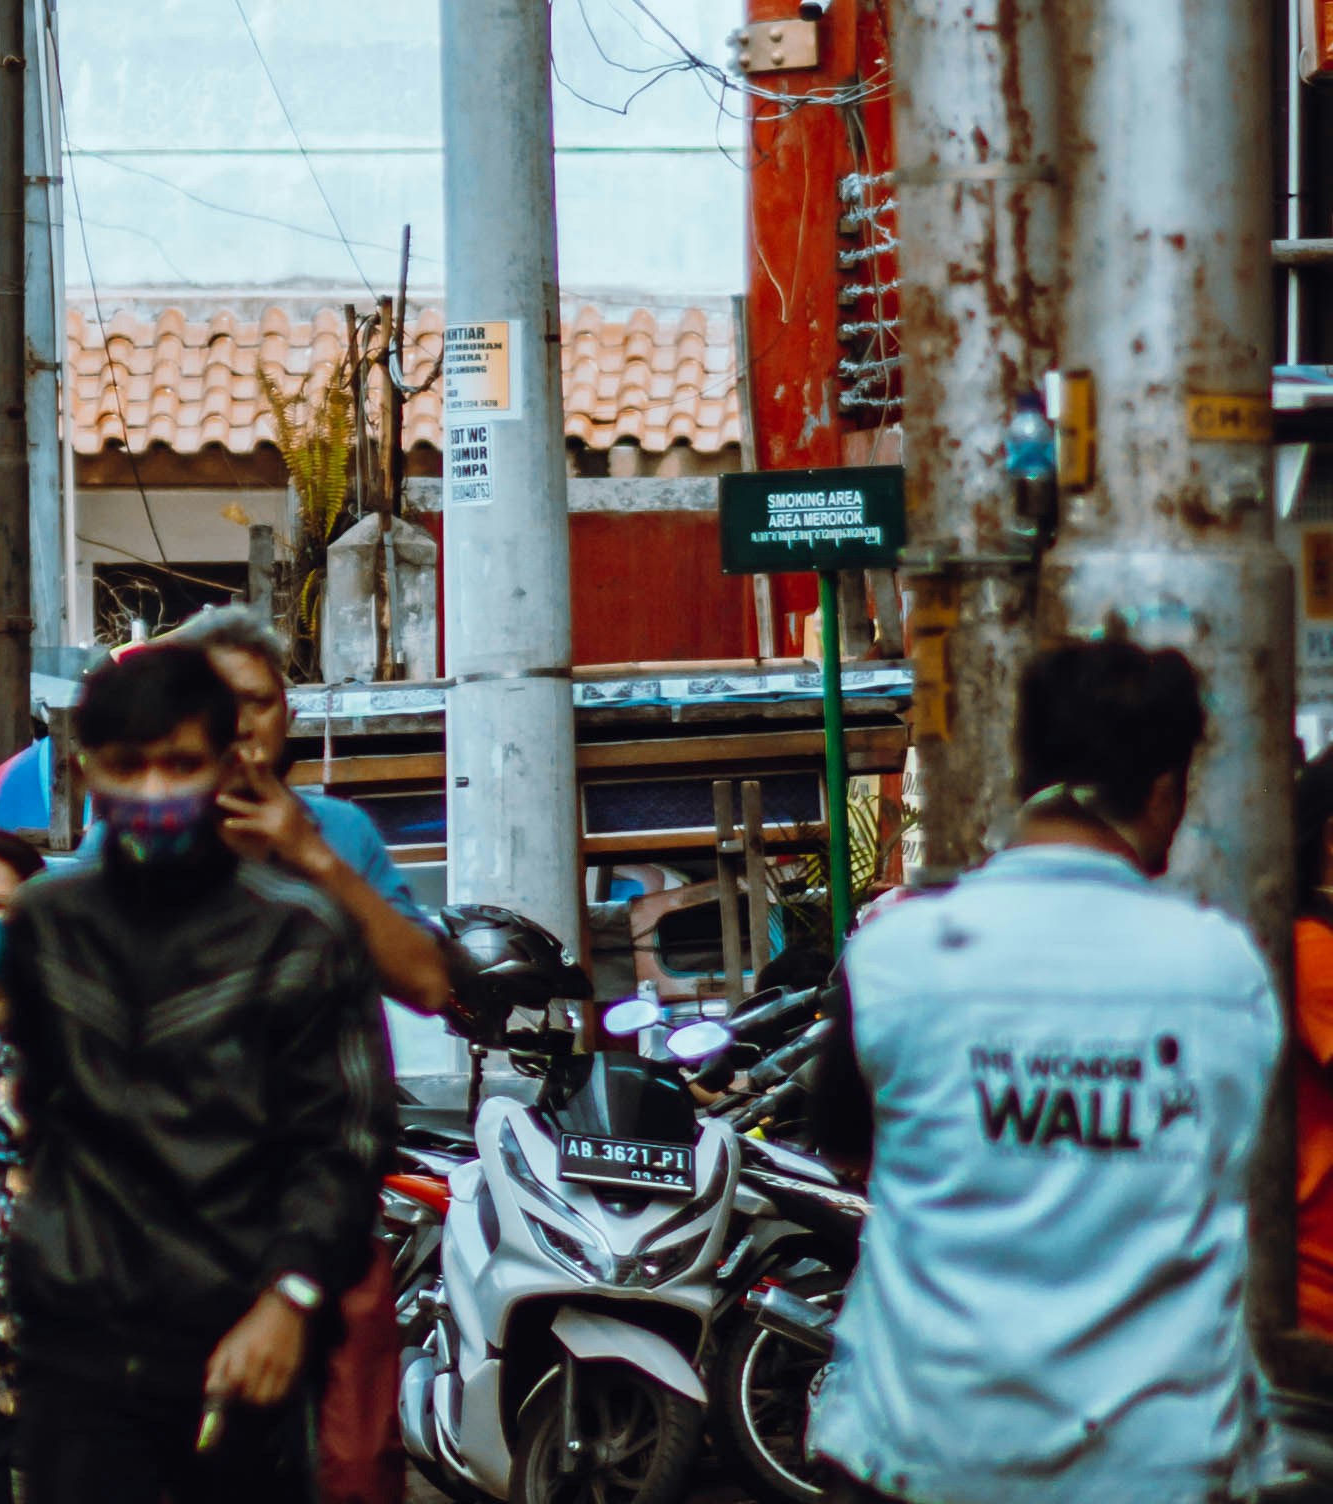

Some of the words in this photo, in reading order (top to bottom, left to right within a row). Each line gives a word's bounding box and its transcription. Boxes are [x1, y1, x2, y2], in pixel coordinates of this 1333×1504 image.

[468, 426, 487, 443] WC
[452, 446, 488, 462] SUMUR
[452, 463, 488, 478] POMPA
[767, 492, 825, 508] SMOKING
[827, 491, 862, 506] AREA
[768, 513, 801, 528] AREA
[803, 511, 863, 526] MEROKOK
[975, 1079, 1140, 1150] WALL
[567, 1139, 593, 1158] AB
[602, 1144, 649, 1165] 3621
